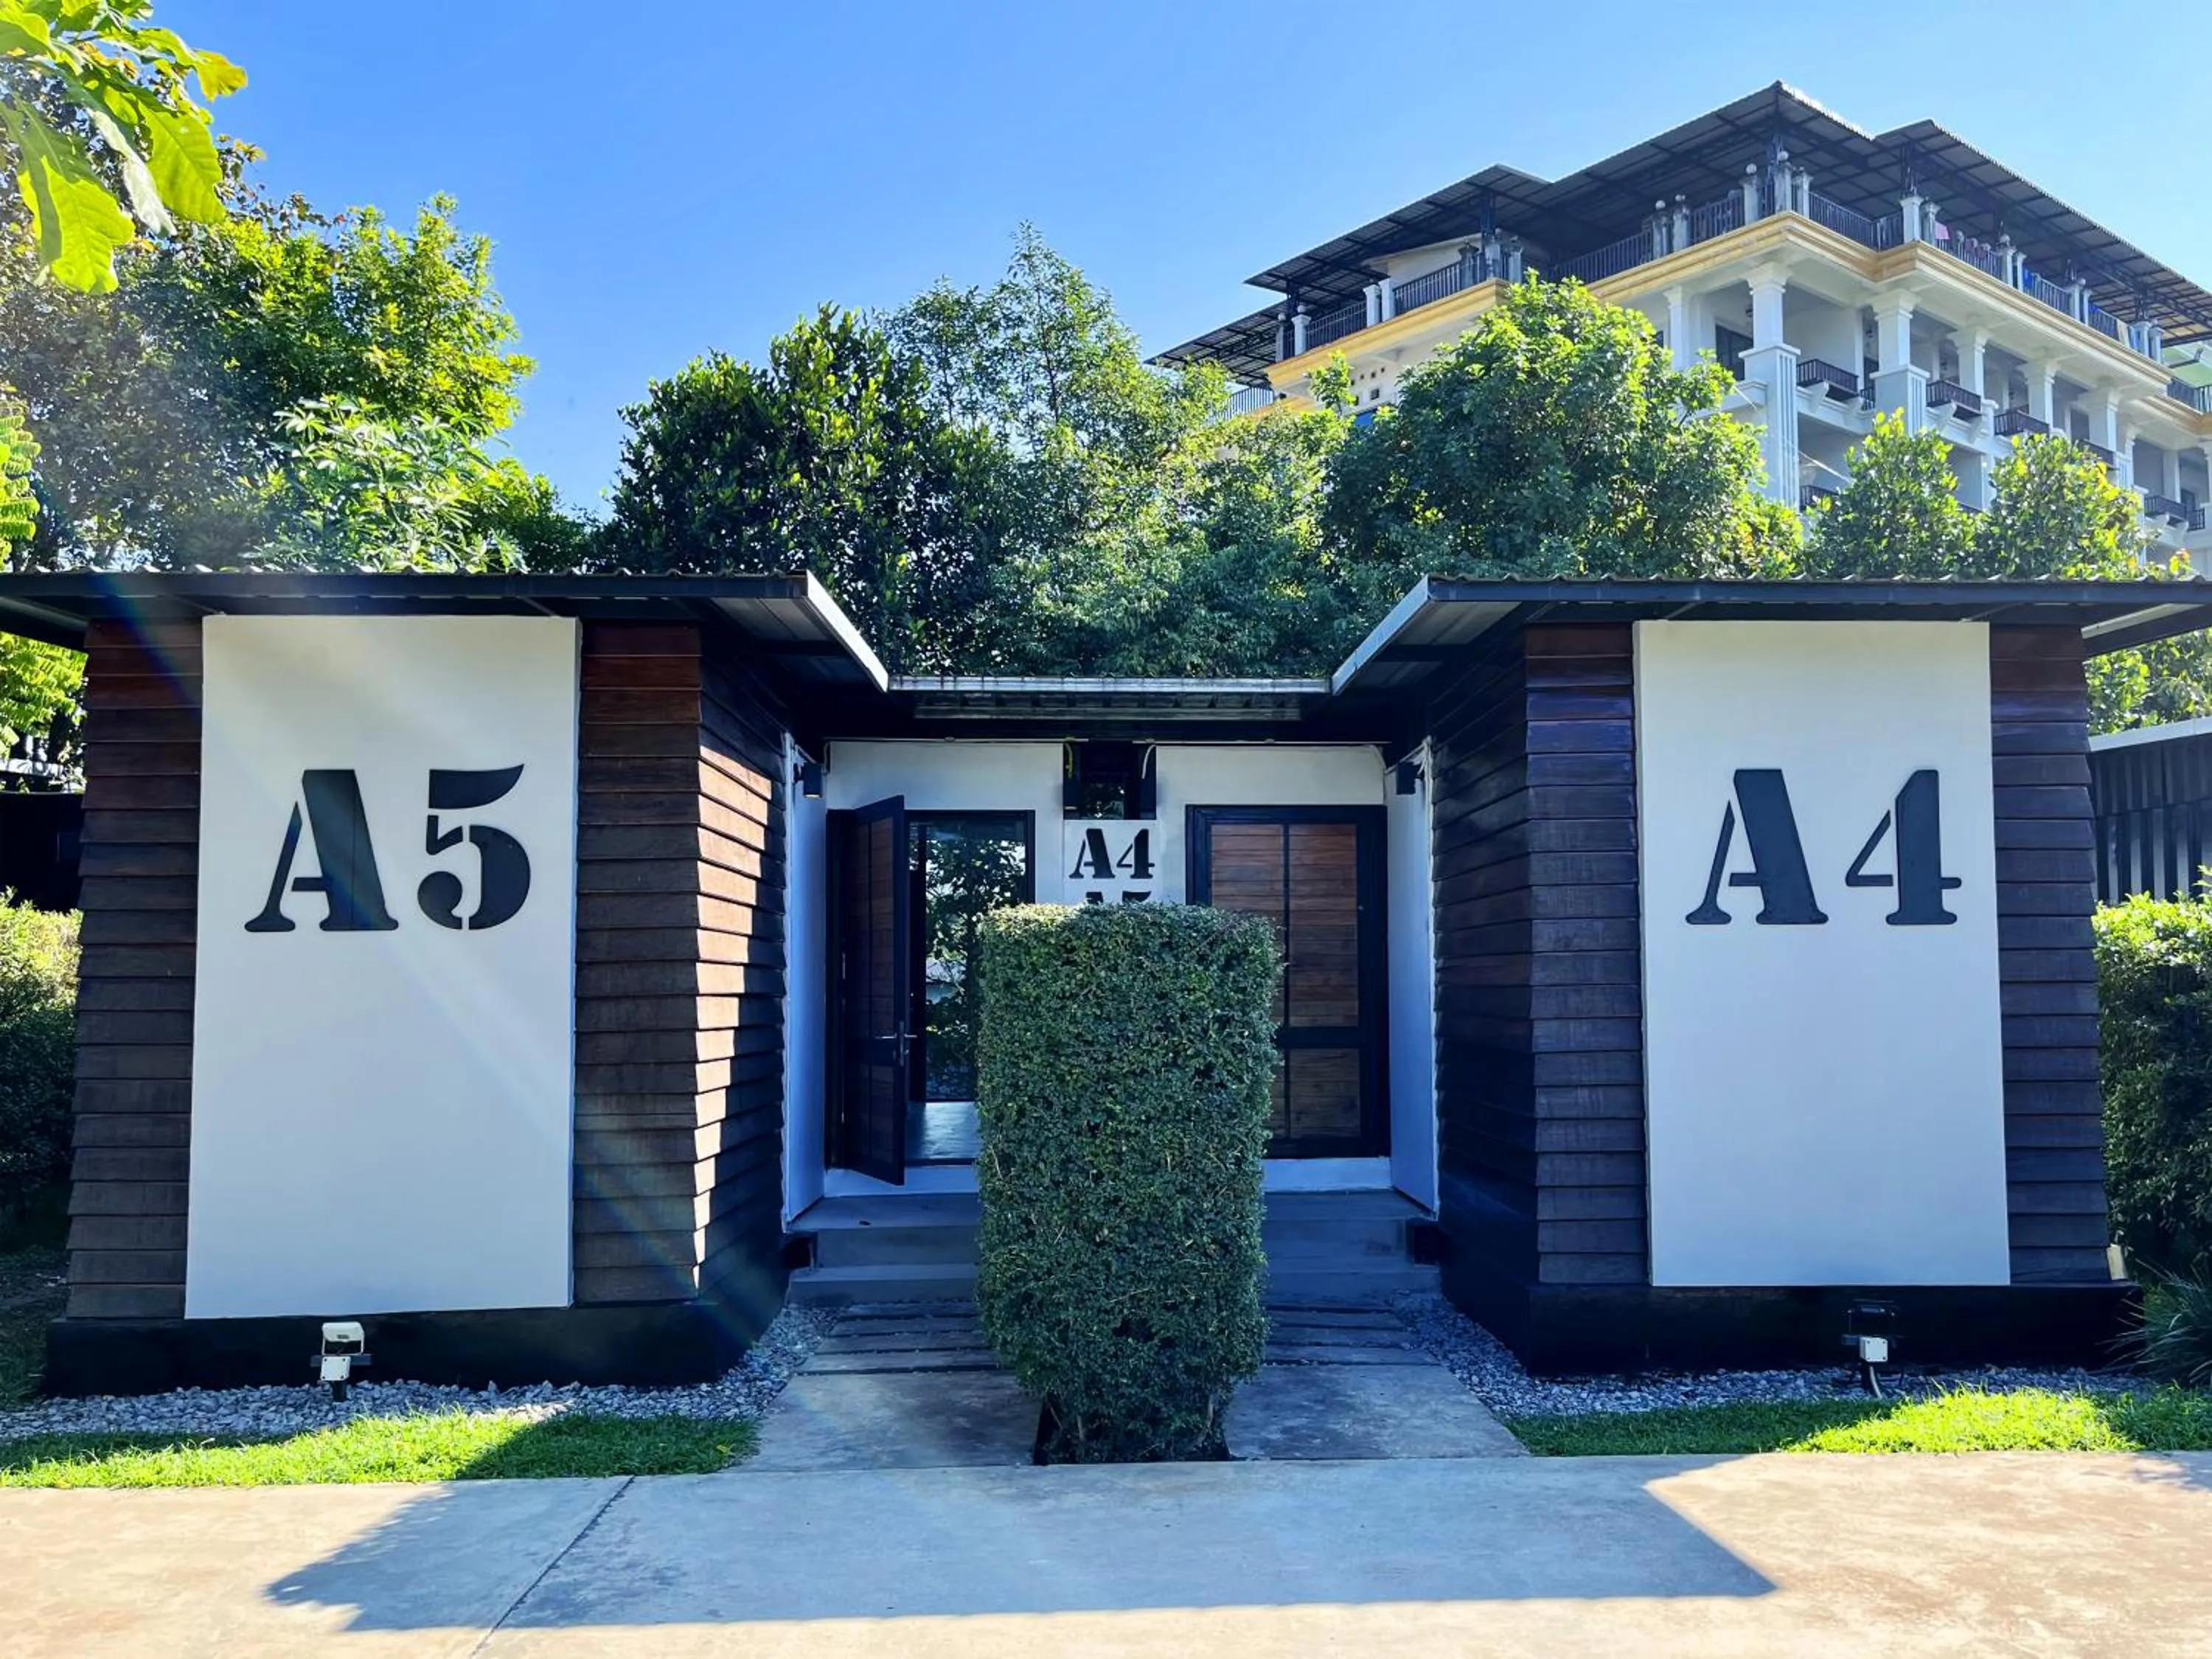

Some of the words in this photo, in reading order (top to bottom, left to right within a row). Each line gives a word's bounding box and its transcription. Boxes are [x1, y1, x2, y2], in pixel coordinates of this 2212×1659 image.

[244, 763, 531, 932] A5
[1069, 828, 1155, 879] A4
[1685, 769, 1962, 925] A4
